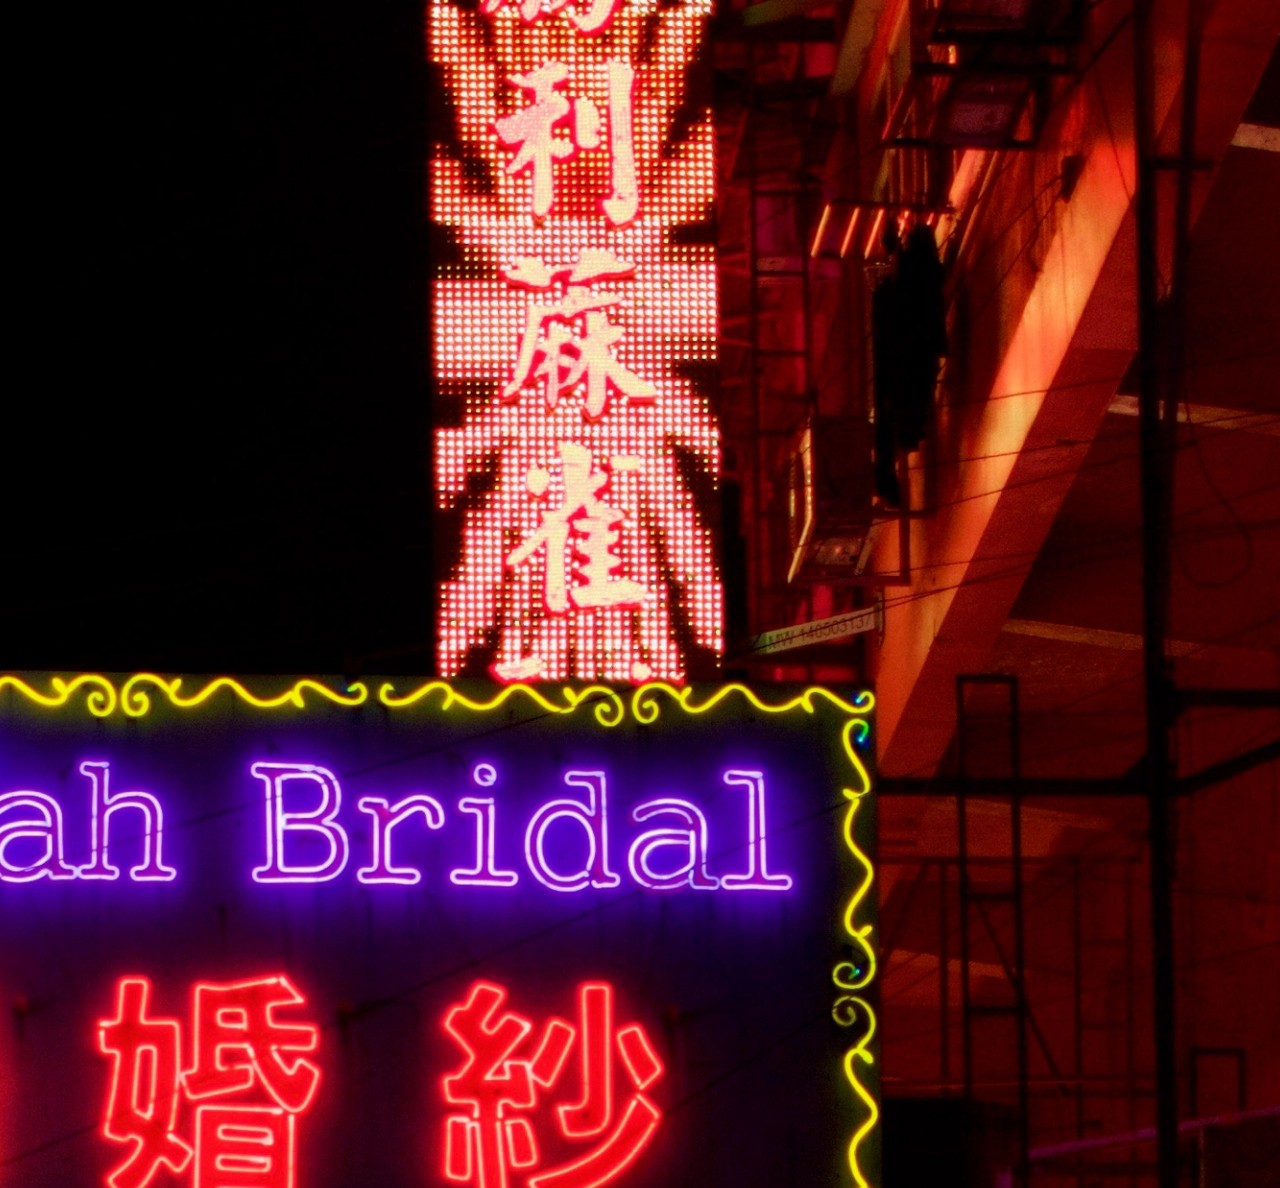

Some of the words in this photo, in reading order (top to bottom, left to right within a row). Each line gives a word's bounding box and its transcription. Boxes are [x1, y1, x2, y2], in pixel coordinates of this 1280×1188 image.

[481, 0, 657, 680] 利麻雀
[251, 762, 793, 892] Bridal
